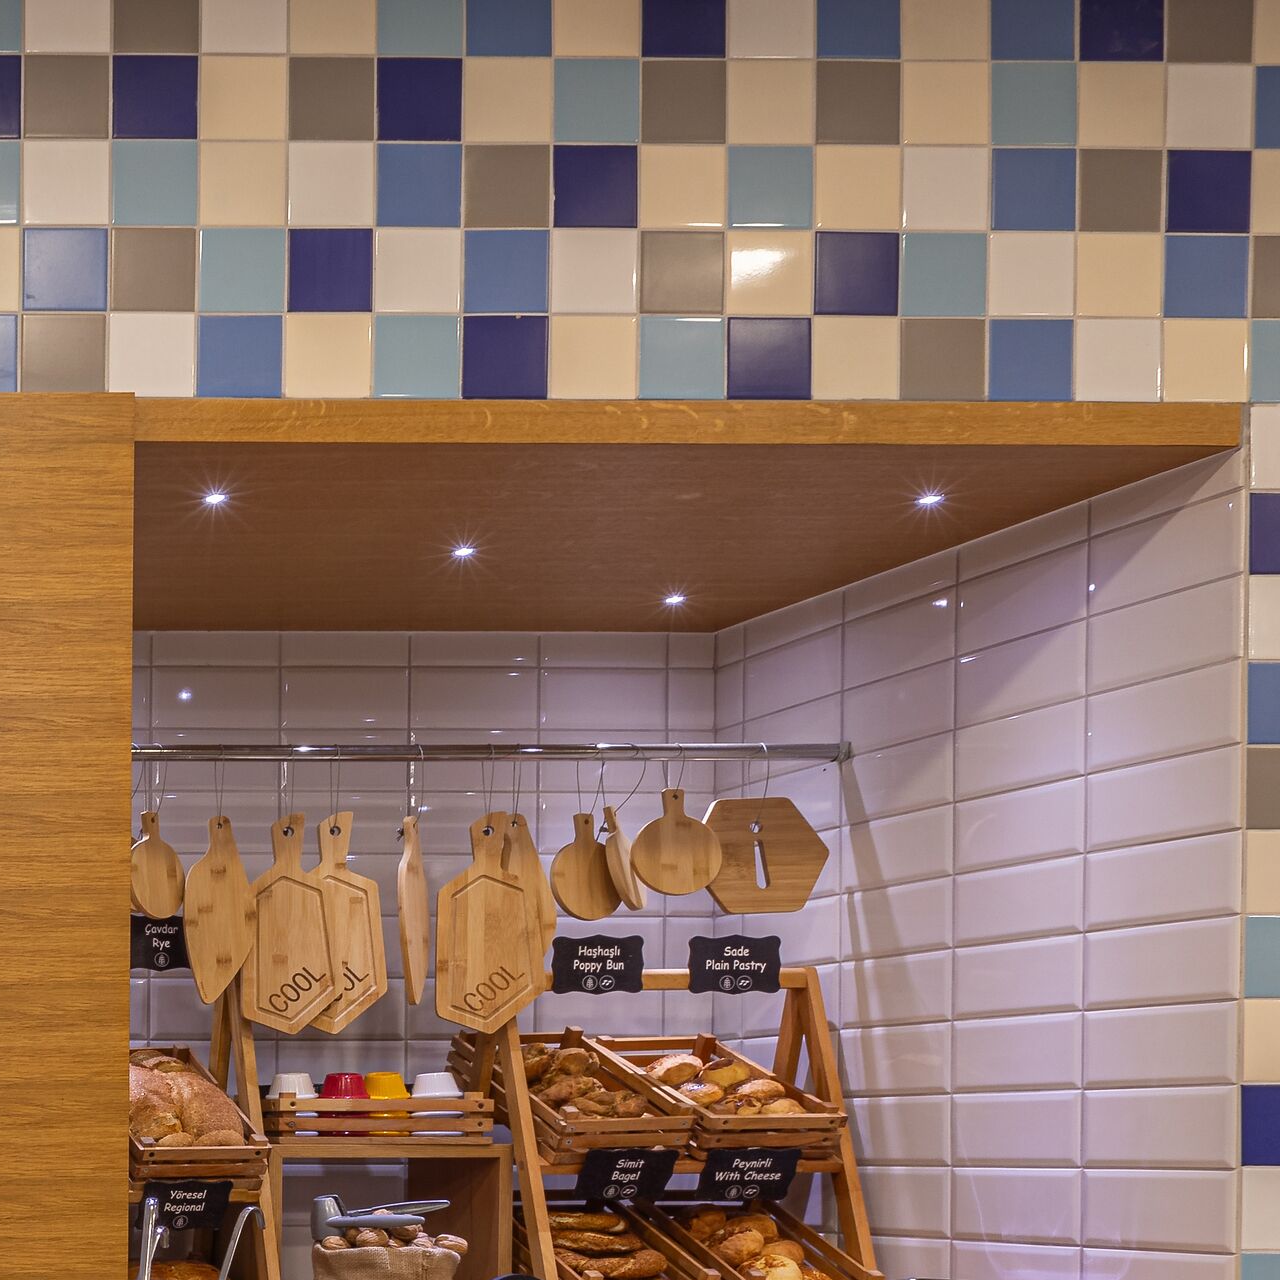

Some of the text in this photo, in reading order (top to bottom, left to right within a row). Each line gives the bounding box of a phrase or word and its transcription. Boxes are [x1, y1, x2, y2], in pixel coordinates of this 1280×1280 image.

[145, 924, 178, 936] Çavdar
[152, 937, 171, 951] Rye
[578, 945, 620, 958] Haşhaşlı
[723, 945, 750, 957] Sade
[573, 960, 624, 973] Poppy Bun
[705, 959, 767, 973] Plain Pastry
[269, 967, 326, 1012] COOL
[464, 966, 525, 1011] COOL
[616, 1159, 645, 1169] Simit
[732, 1158, 773, 1170] Peynirli
[611, 1171, 641, 1182] Bagel
[715, 1171, 782, 1181] With Cheese
[170, 1189, 208, 1200] Yöresel
[163, 1202, 206, 1214] Regional
